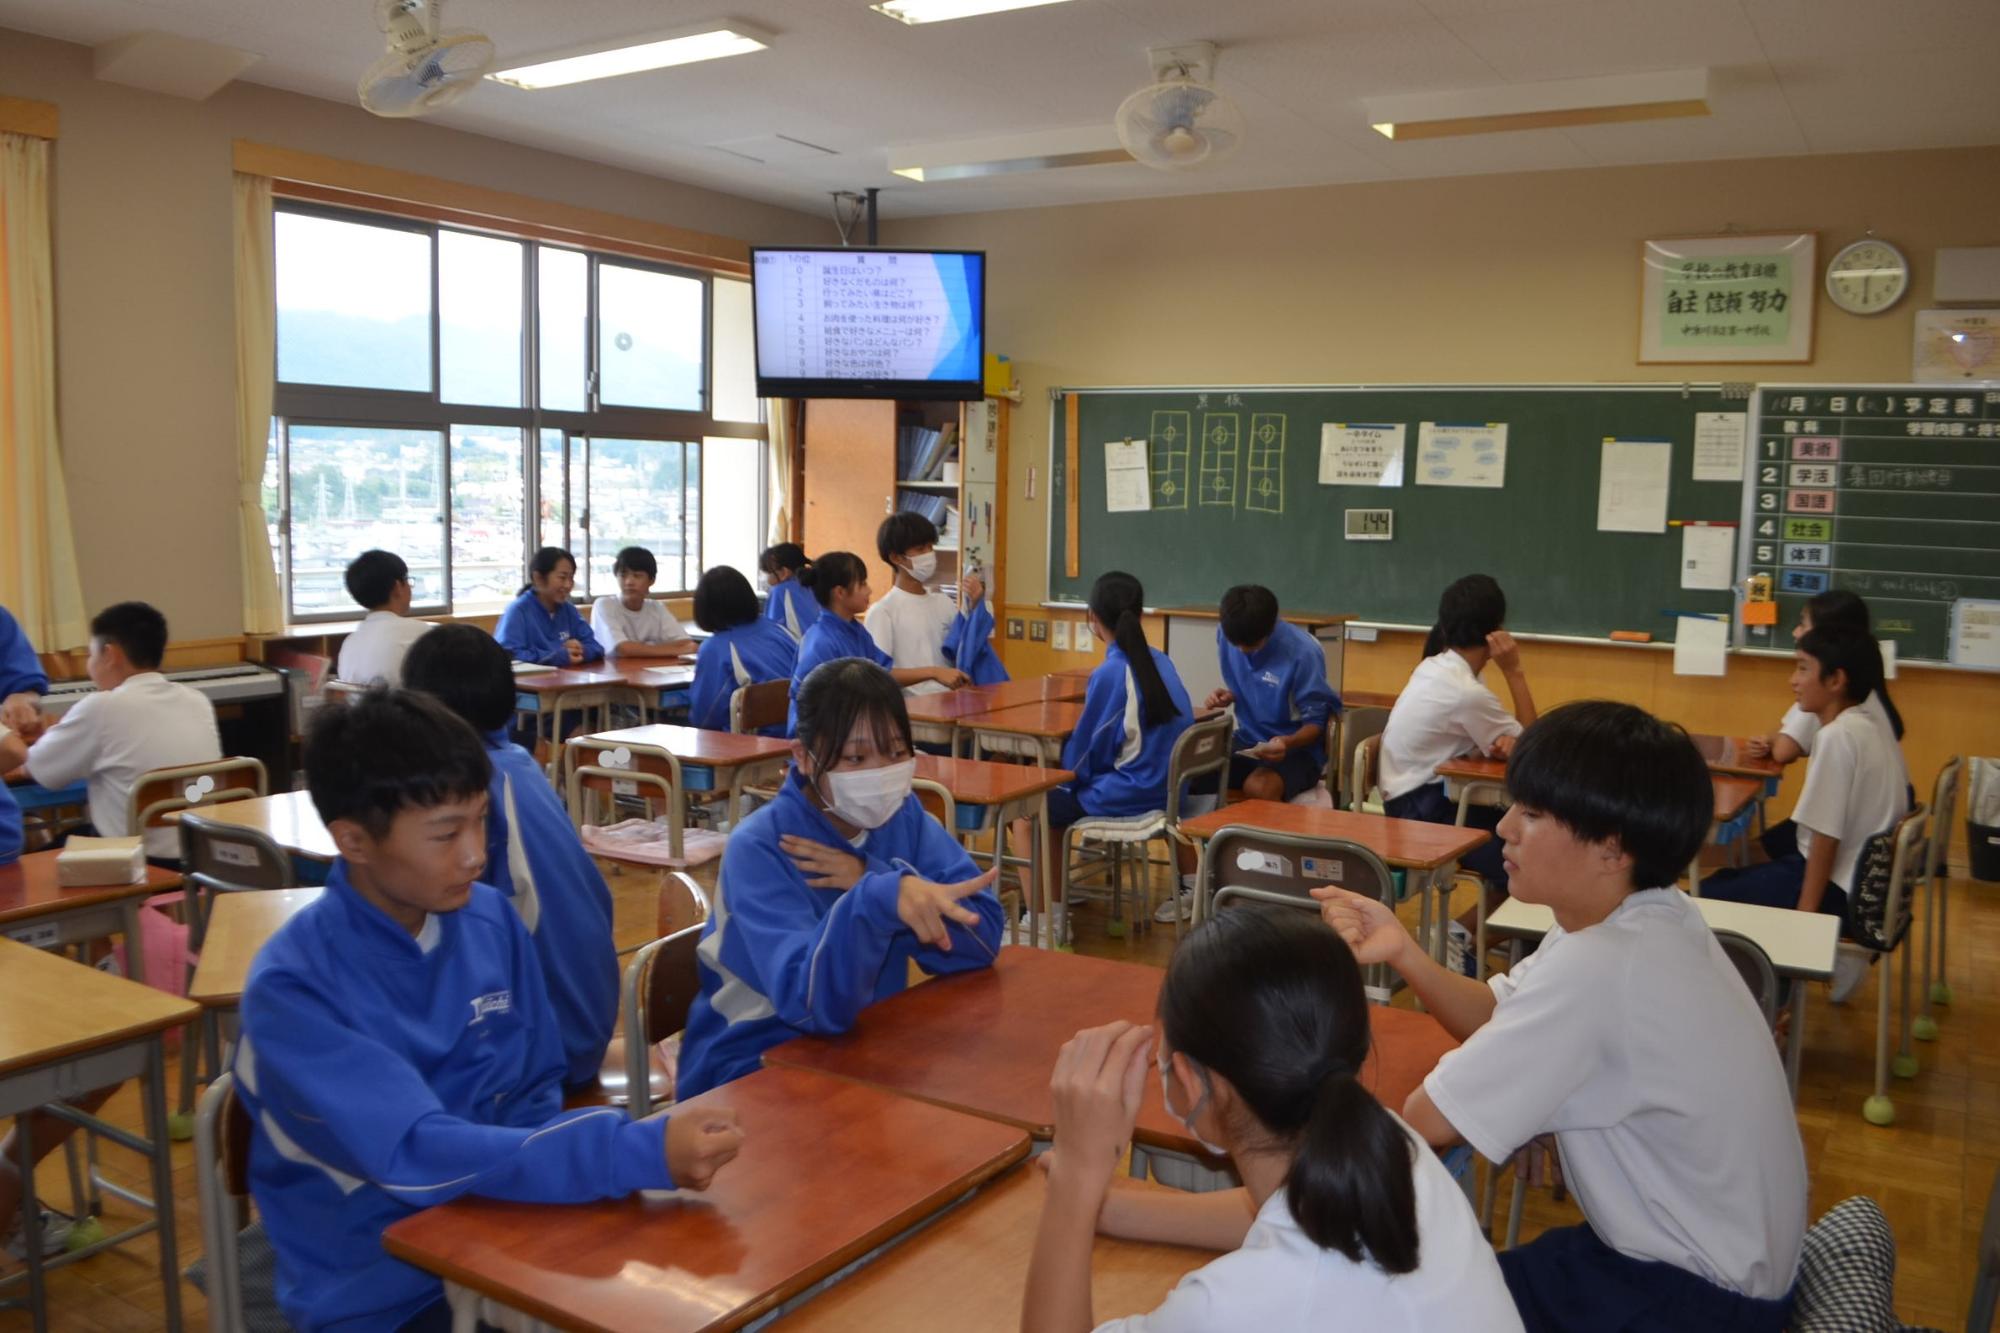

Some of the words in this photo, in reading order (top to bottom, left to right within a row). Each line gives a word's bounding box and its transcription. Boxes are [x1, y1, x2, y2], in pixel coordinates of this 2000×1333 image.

[1667, 289, 1698, 315] 自主
[1706, 290, 1743, 314] 信頼
[1746, 288, 1788, 314] 努力
[1766, 441, 1778, 457] 1
[1800, 441, 1833, 457] 美術
[1761, 467, 1778, 483] 2
[1797, 469, 1829, 484] 学活
[1760, 493, 1777, 509] 3
[1795, 494, 1827, 509] 国語
[1758, 520, 1775, 536] 4
[1791, 522, 1824, 538] 社会
[1757, 545, 1774, 561] 5
[1790, 548, 1822, 563] 体育
